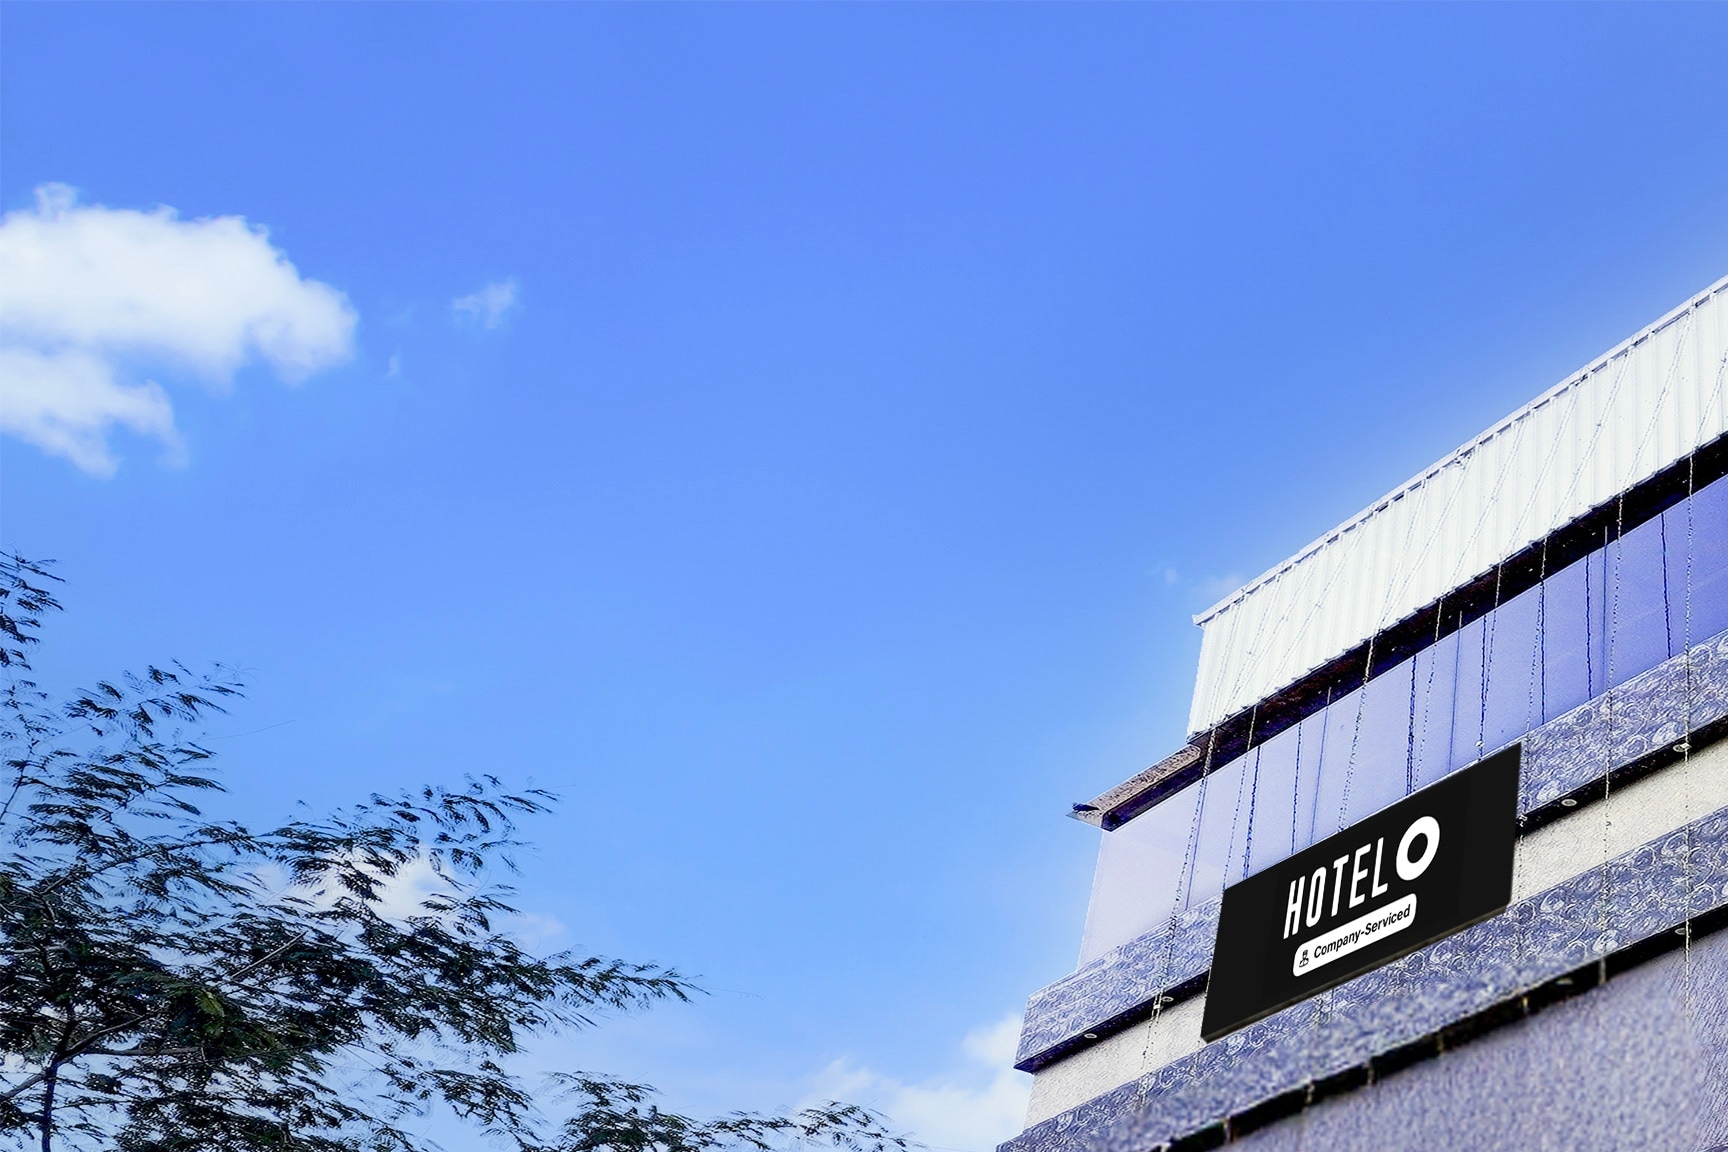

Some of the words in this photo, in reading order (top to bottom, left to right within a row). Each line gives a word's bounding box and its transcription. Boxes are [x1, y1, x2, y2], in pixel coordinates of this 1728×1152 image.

[1283, 837, 1388, 940] HOTEL
[1396, 815, 1441, 881] O
[1313, 903, 1411, 958] Company-Serviced
